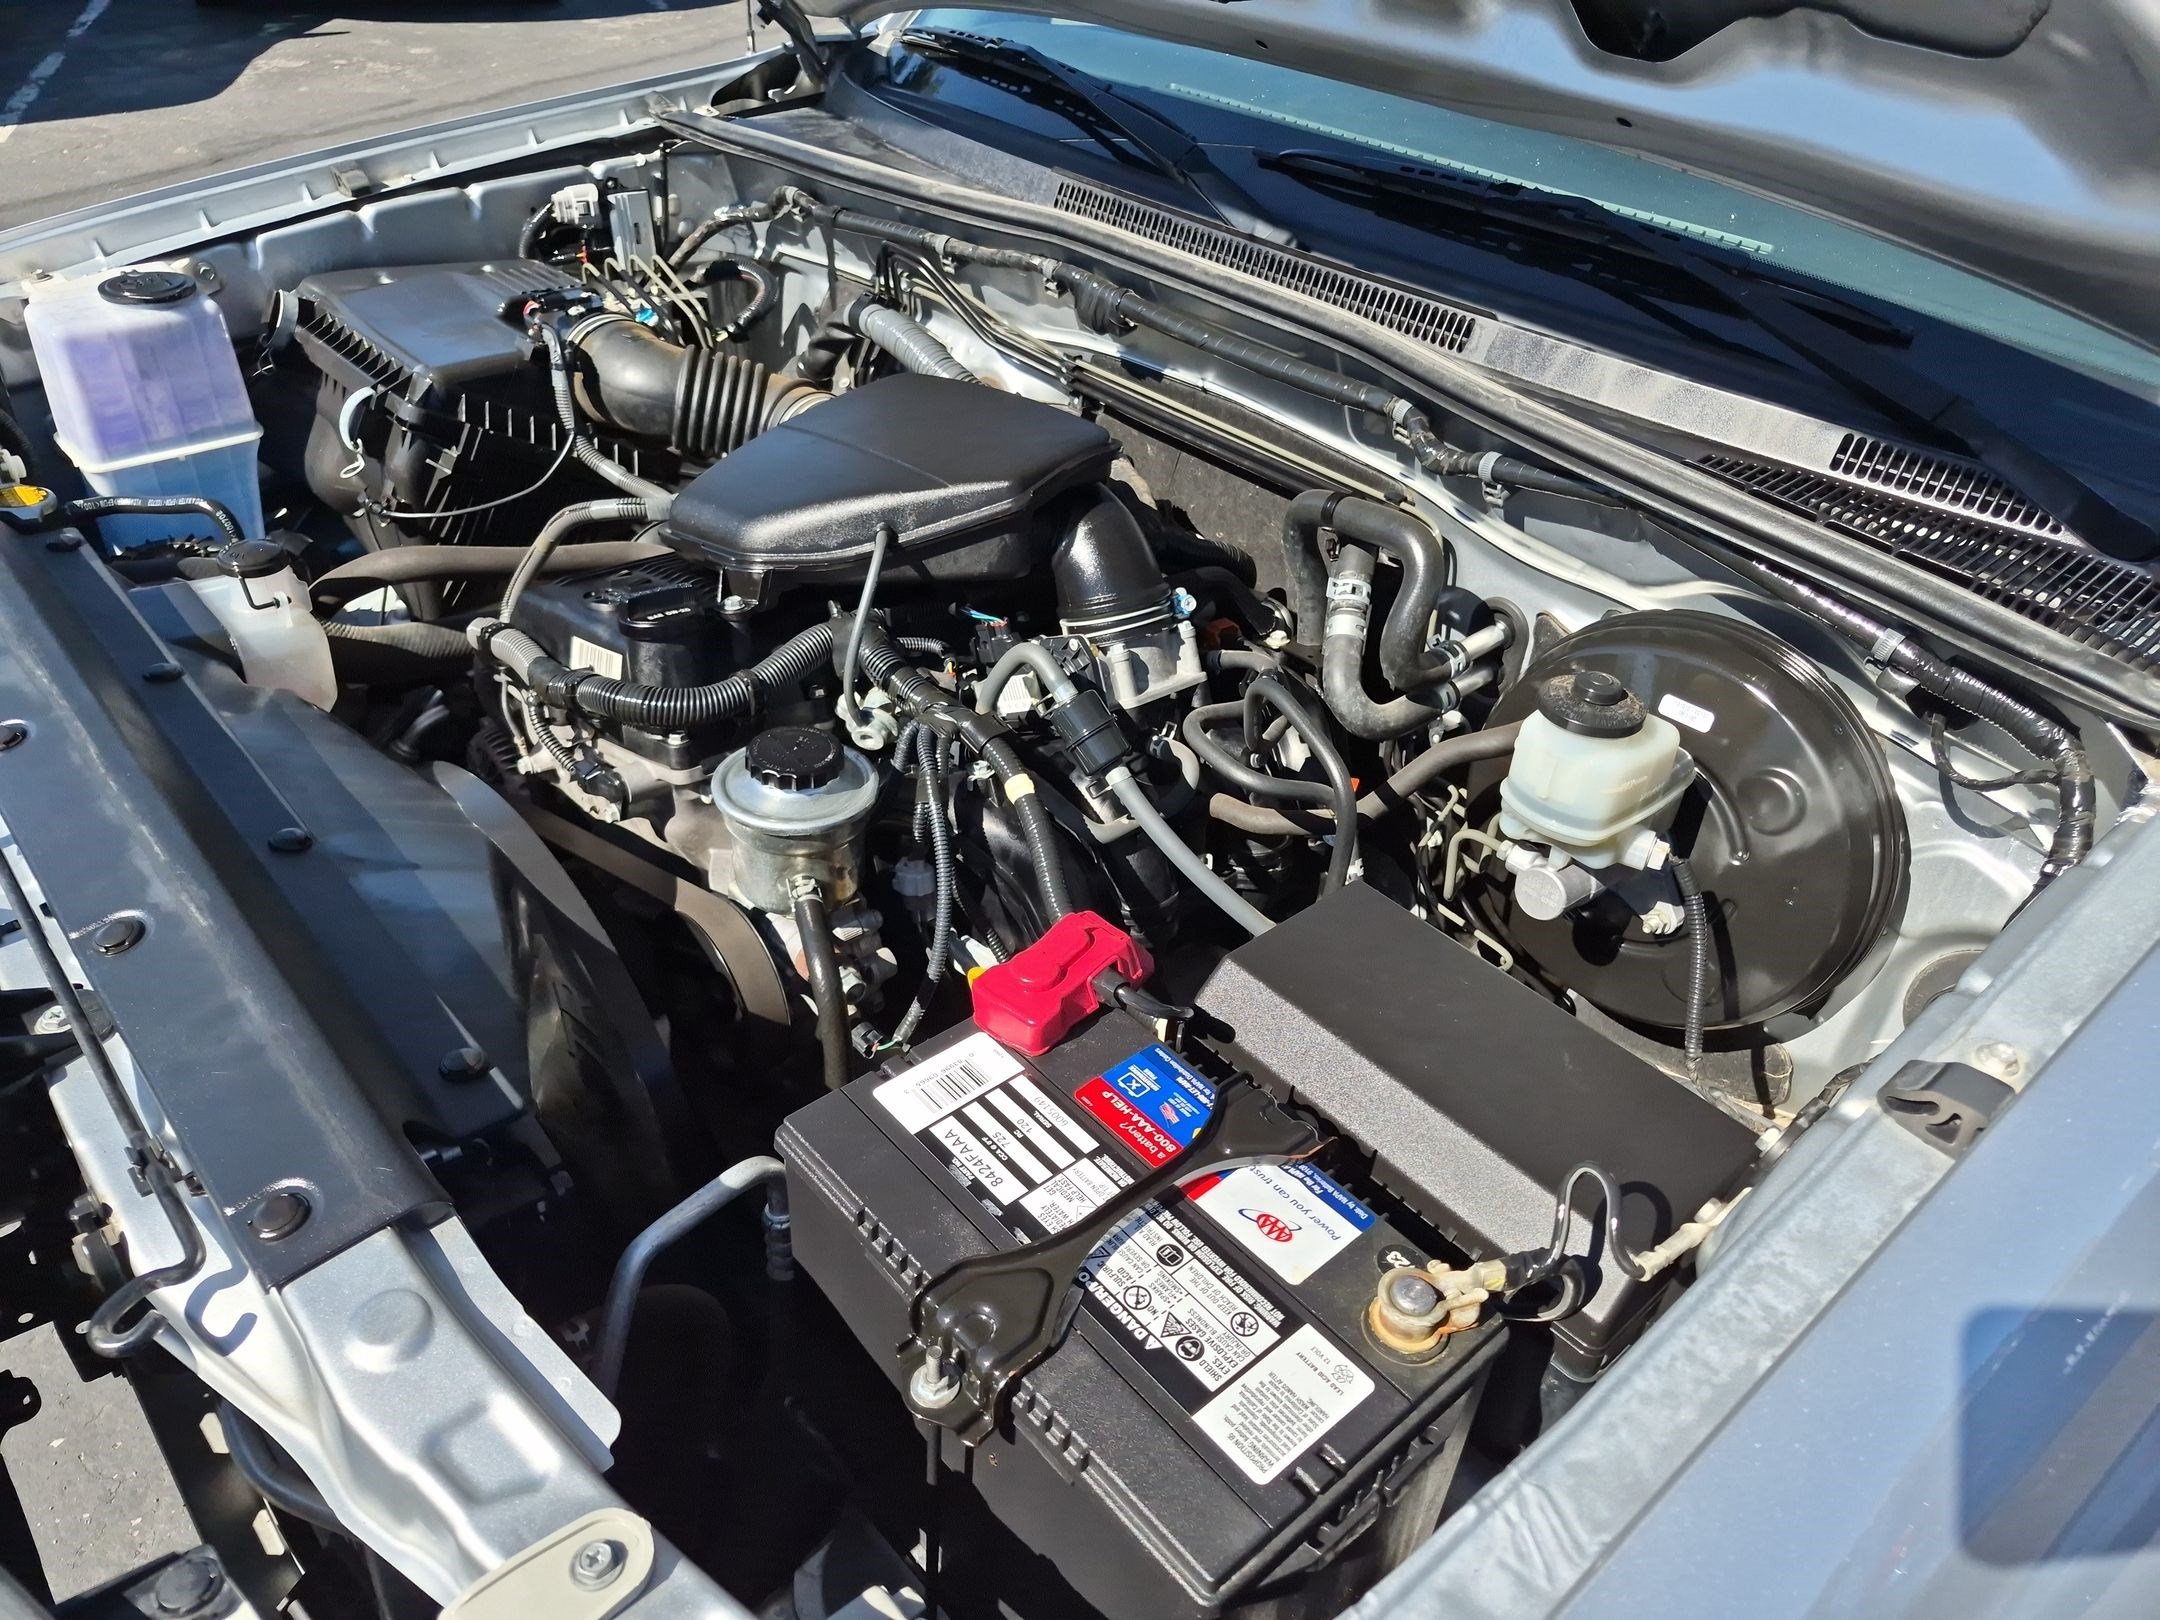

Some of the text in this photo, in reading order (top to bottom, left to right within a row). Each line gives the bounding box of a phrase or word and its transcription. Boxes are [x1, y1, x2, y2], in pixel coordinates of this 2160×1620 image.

[1031, 1110, 1052, 1128] SERIAL
[1033, 1095, 1069, 1126] 6005149
[1015, 1117, 1034, 1133] 120
[1100, 1088, 1177, 1154] 800-AAA-HELP
[991, 1130, 1012, 1148] 725
[1013, 1129, 1024, 1138] RC
[1117, 1119, 1166, 1159] a battery?
[941, 1128, 1005, 1187] 8424FAAA
[994, 1148, 1008, 1160] CCA
[950, 1156, 975, 1179] PART NO.
[1043, 1184, 1057, 1195] GET
[1071, 1166, 1105, 1197] OPEN BATTERY
[1301, 1175, 1315, 1186] the
[1309, 1183, 1323, 1194] For
[1049, 1179, 1075, 1202] MEDICAL
[1070, 1188, 1086, 1203] HELP
[1271, 1183, 1291, 1199] can
[1288, 1197, 1312, 1216] you
[1345, 1199, 1356, 1209] by
[1037, 1212, 1054, 1226] EYES
[1169, 1217, 1193, 1237] FOLLOW
[1254, 1212, 1293, 1244] AAA
[1308, 1213, 1341, 1241] Power
[1141, 1233, 1157, 1246] READ
[1186, 1242, 1197, 1251] OR
[1116, 1248, 1143, 1273] CAN CAUSE
[1123, 1244, 1150, 1268] OR SEVERE
[1194, 1249, 1223, 1275] EXPLOSION
[1096, 1259, 1126, 1287] SULFURIC
[1116, 1266, 1133, 1281] ACID
[1222, 1265, 1237, 1277] FOR
[1187, 1265, 1238, 1311] REACH OF CHILDREN
[1188, 1276, 1232, 1315] KEEP OUT OF THE
[1232, 1283, 1244, 1293] OF
[1239, 1290, 1256, 1304] RISK
[1146, 1304, 1158, 1315] NO
[1269, 1307, 1285, 1321] NOT
[1184, 1317, 1239, 1368] EXPLOSIVE GASES
[1186, 1307, 1245, 1362] CAN CAUSE BLINDNESS
[1239, 1347, 1251, 1357] OR
[1310, 1345, 1325, 1359] VOLT
[1197, 1358, 1222, 1381] SHIELD
[1295, 1350, 1344, 1395] LEAD ACID BATTERY
[1232, 1437, 1269, 1473] PROPOSITION
